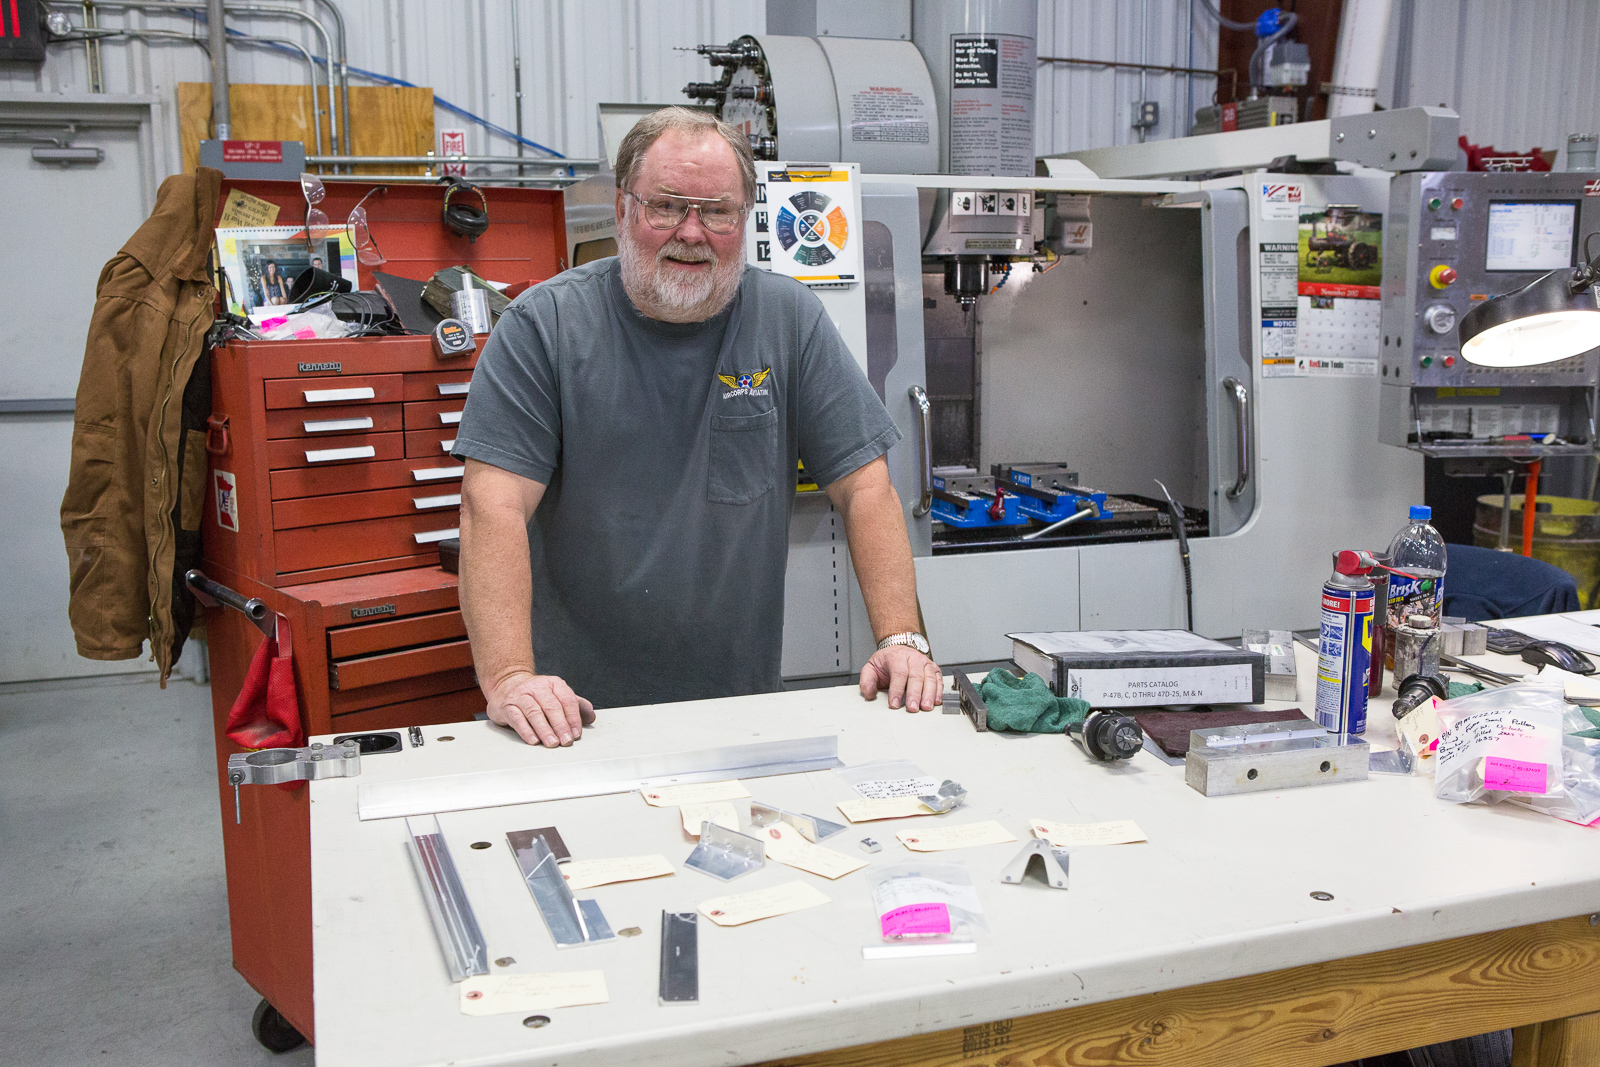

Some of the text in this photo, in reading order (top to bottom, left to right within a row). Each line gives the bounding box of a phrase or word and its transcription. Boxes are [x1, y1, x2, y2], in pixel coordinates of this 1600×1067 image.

[445, 141, 462, 152] FIRE
[298, 361, 342, 373] Kennedy
[933, 479, 945, 489] KURT
[1018, 475, 1031, 484] KURT
[1323, 598, 1340, 609] MORE!
[351, 603, 396, 619] Kennedy
